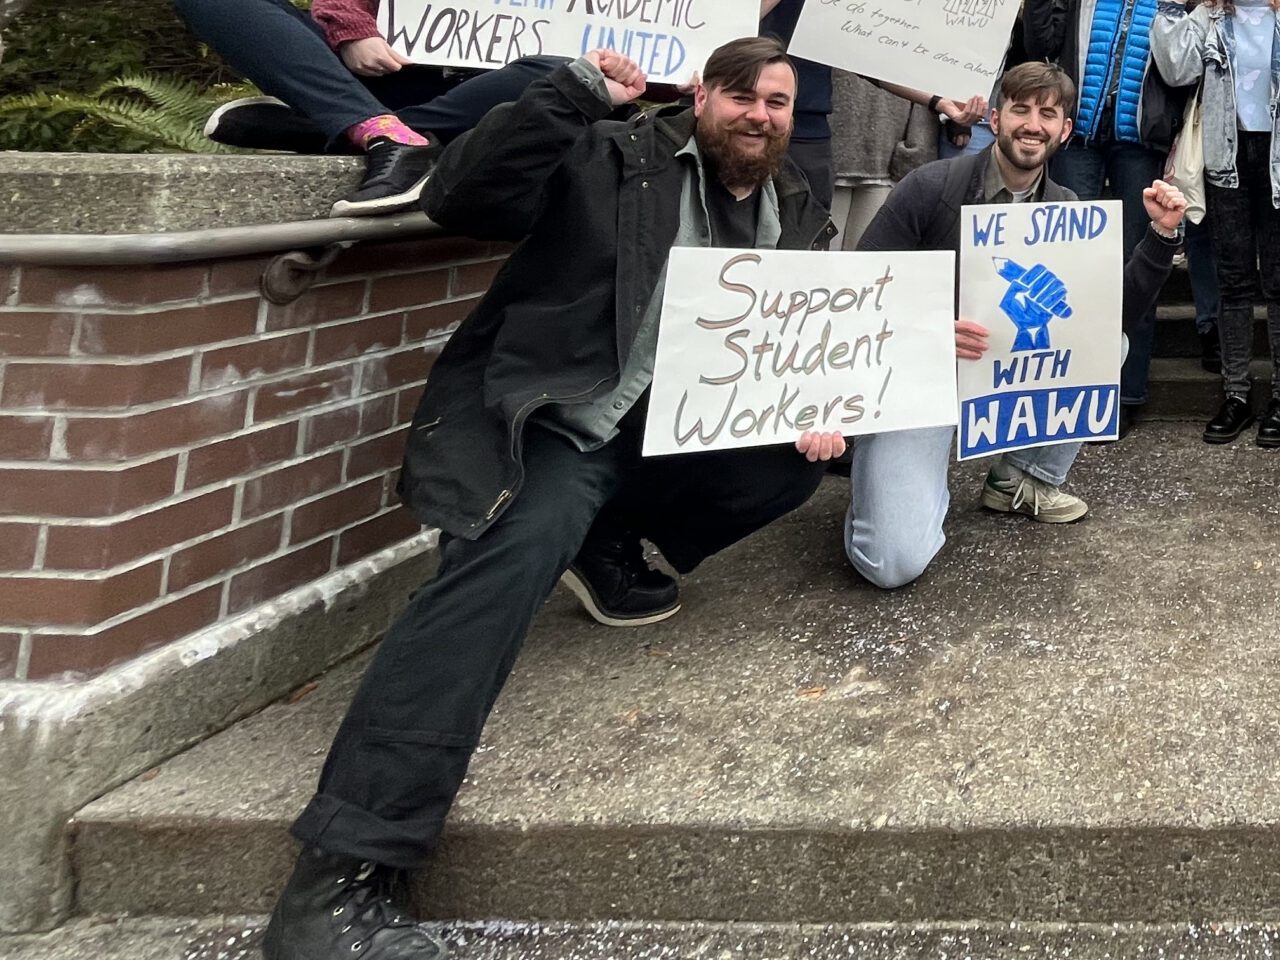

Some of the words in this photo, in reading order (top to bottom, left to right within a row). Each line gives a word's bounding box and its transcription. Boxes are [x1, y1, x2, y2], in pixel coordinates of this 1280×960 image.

[846, 2, 866, 14] do
[870, 8, 920, 30] together
[945, 13, 988, 29] WAWU
[840, 20, 873, 38] What
[911, 43, 930, 55] be
[933, 52, 959, 66] done
[972, 212, 1008, 247] WE
[1024, 205, 1107, 246] STAND
[695, 253, 893, 336] Support
[699, 319, 893, 386] Student
[993, 349, 1071, 389] WITH
[673, 366, 892, 446] Workers!
[967, 389, 1116, 449] WAWU
